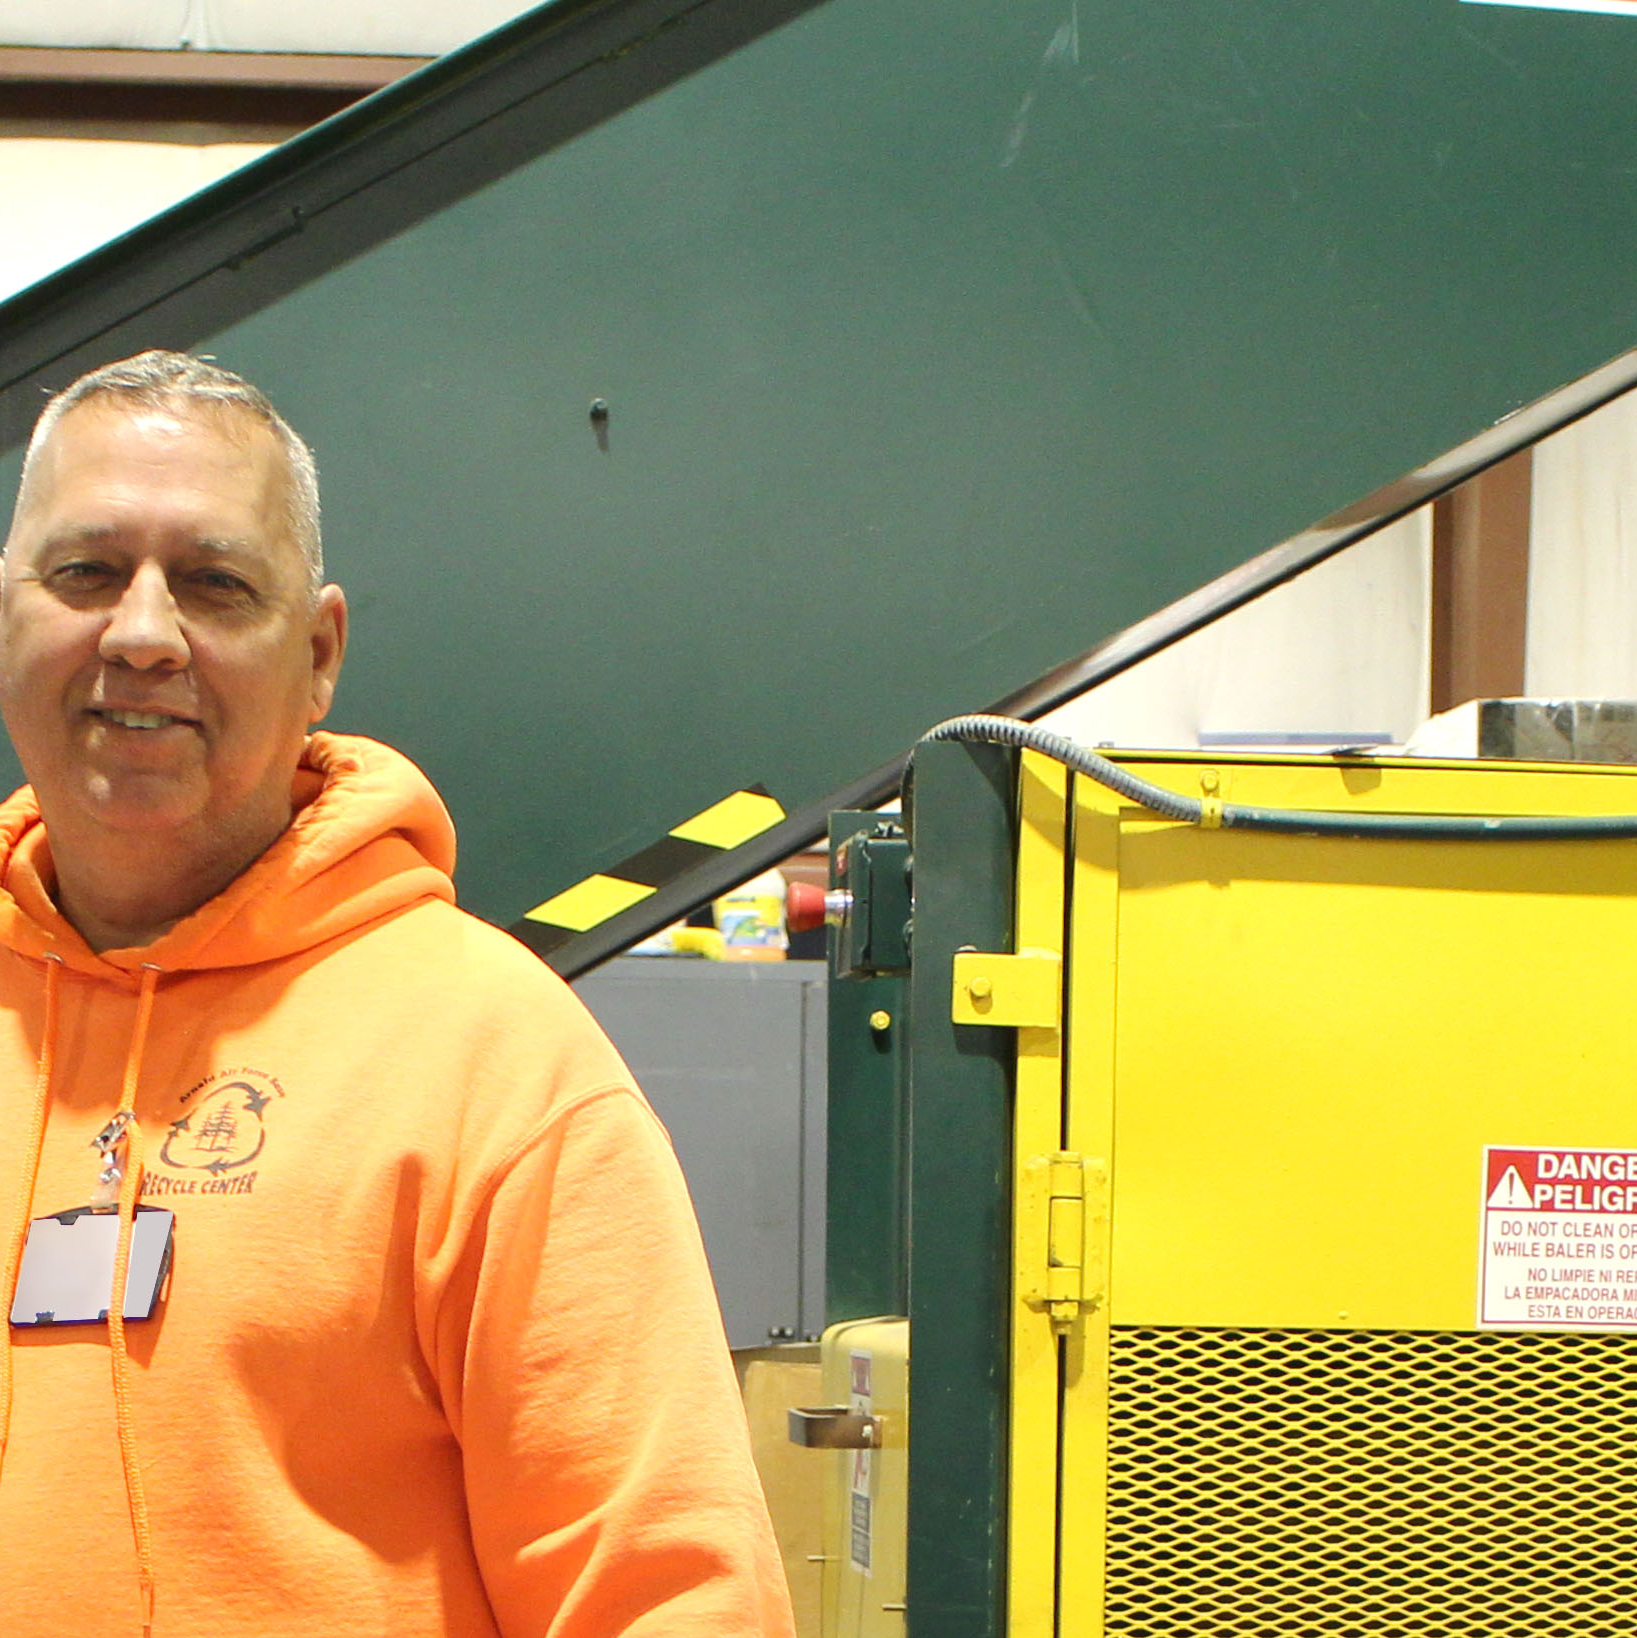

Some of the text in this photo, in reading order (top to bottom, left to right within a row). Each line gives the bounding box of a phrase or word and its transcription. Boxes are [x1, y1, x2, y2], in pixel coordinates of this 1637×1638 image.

[140, 1170, 258, 1196] RECYCLE CENTER
[1501, 1220, 1523, 1236] DO
[1528, 1221, 1558, 1237] NOT
[1562, 1222, 1614, 1238] CLEAN
[1493, 1241, 1541, 1258] WHILE
[1545, 1242, 1596, 1259] BALER
[1600, 1244, 1615, 1260] IS
[1528, 1268, 1547, 1282] NO
[1551, 1268, 1596, 1283] LIMPIE
[1599, 1270, 1613, 1283] NI
[1504, 1286, 1521, 1300] LA
[1525, 1286, 1619, 1302] EMPACADORA
[1528, 1304, 1562, 1319] ESTA
[1565, 1305, 1584, 1319] EN
